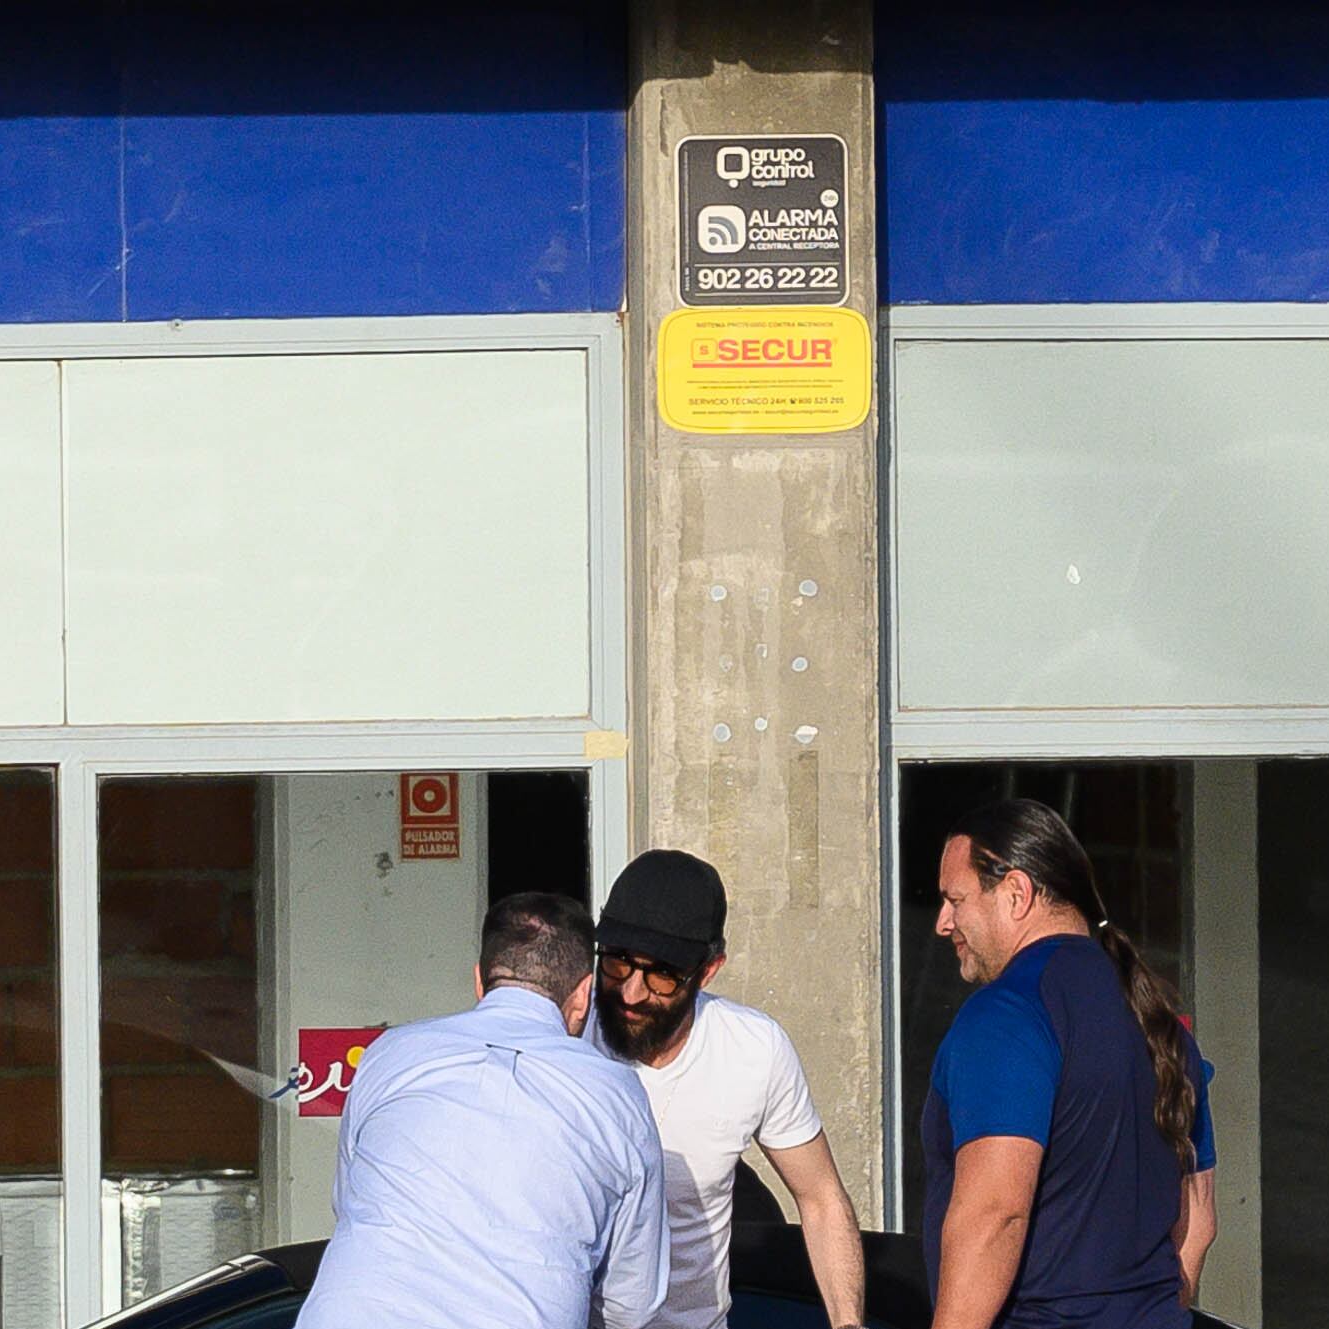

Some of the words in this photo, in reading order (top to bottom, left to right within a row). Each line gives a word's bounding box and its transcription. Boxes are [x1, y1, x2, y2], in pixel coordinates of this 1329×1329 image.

[751, 148, 806, 166] grupo
[751, 160, 815, 179] control
[748, 209, 838, 226] ALARMA
[748, 228, 838, 241] CONECTADA
[756, 242, 792, 250] CENTRAL
[698, 268, 741, 290] 902
[744, 268, 774, 289] 26
[777, 268, 806, 288] 22
[809, 267, 838, 288] 22
[718, 339, 832, 361] SECUR
[405, 831, 456, 842] PULSADOR
